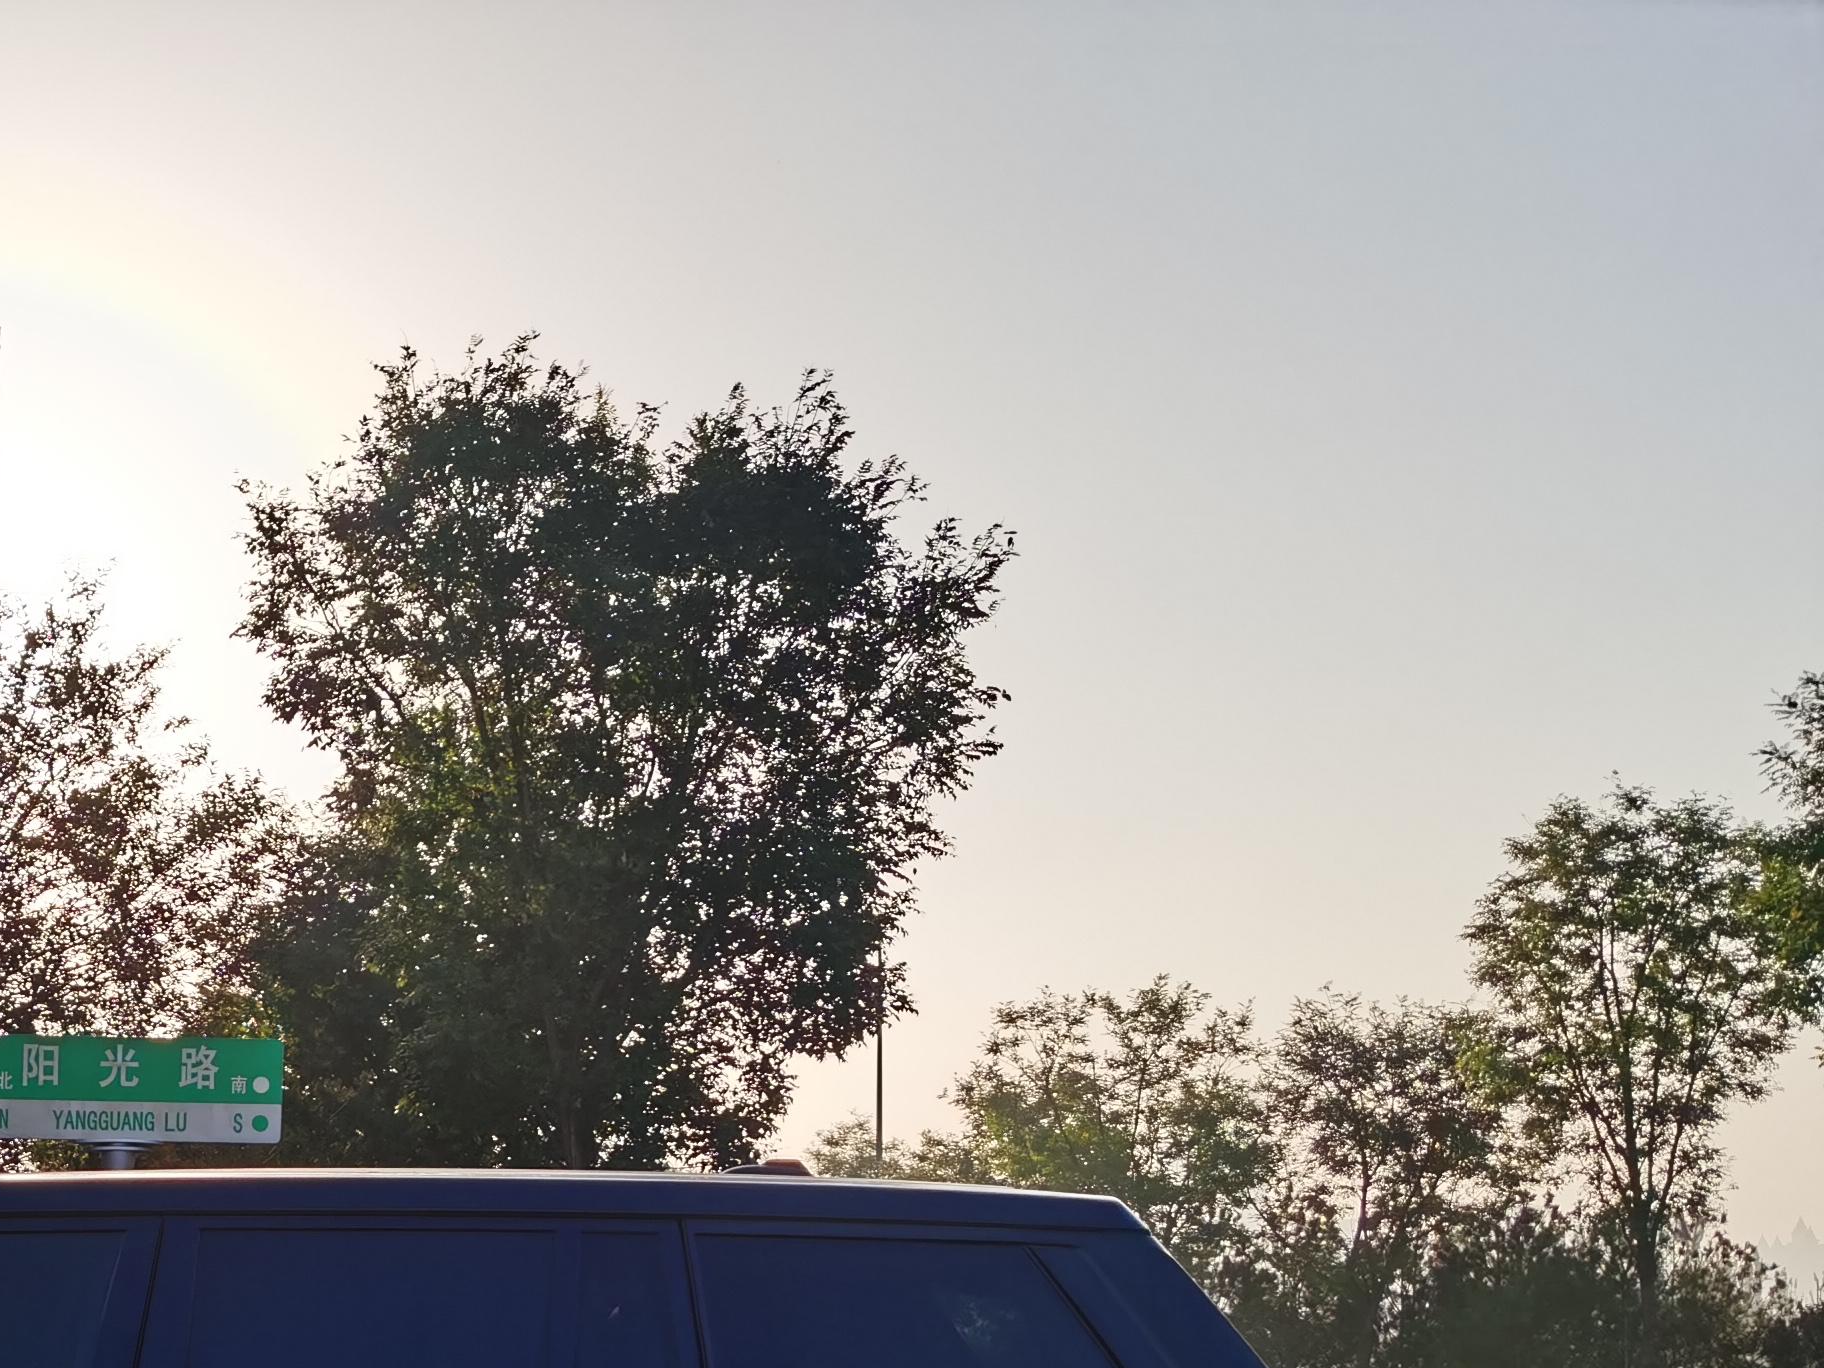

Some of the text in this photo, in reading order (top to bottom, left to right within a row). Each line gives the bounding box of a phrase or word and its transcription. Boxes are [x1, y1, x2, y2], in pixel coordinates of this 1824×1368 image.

[22, 1043, 219, 1090] 阳光路
[231, 1075, 248, 1095] 南
[0, 1108, 9, 1129] N
[52, 1109, 187, 1132] YANGGUANG LU
[233, 1113, 243, 1133] S
